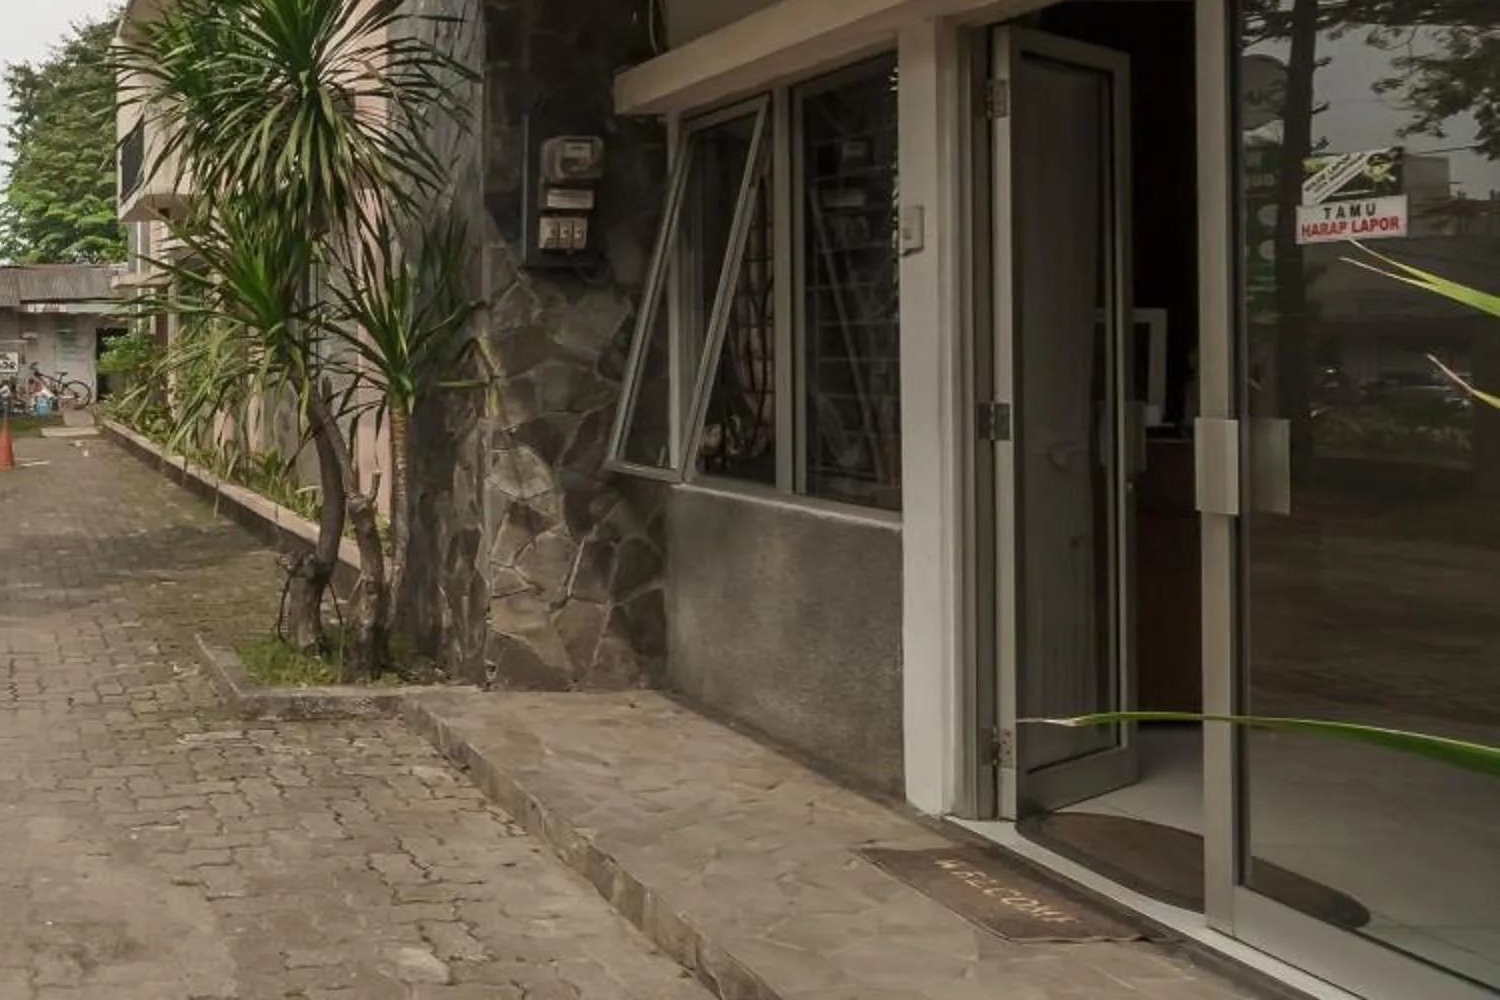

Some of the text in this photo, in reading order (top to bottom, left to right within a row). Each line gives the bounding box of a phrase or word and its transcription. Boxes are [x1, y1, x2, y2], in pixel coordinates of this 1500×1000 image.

[1323, 203, 1376, 219] TAMU
[1301, 216, 1399, 237] HARAP LAPOR
